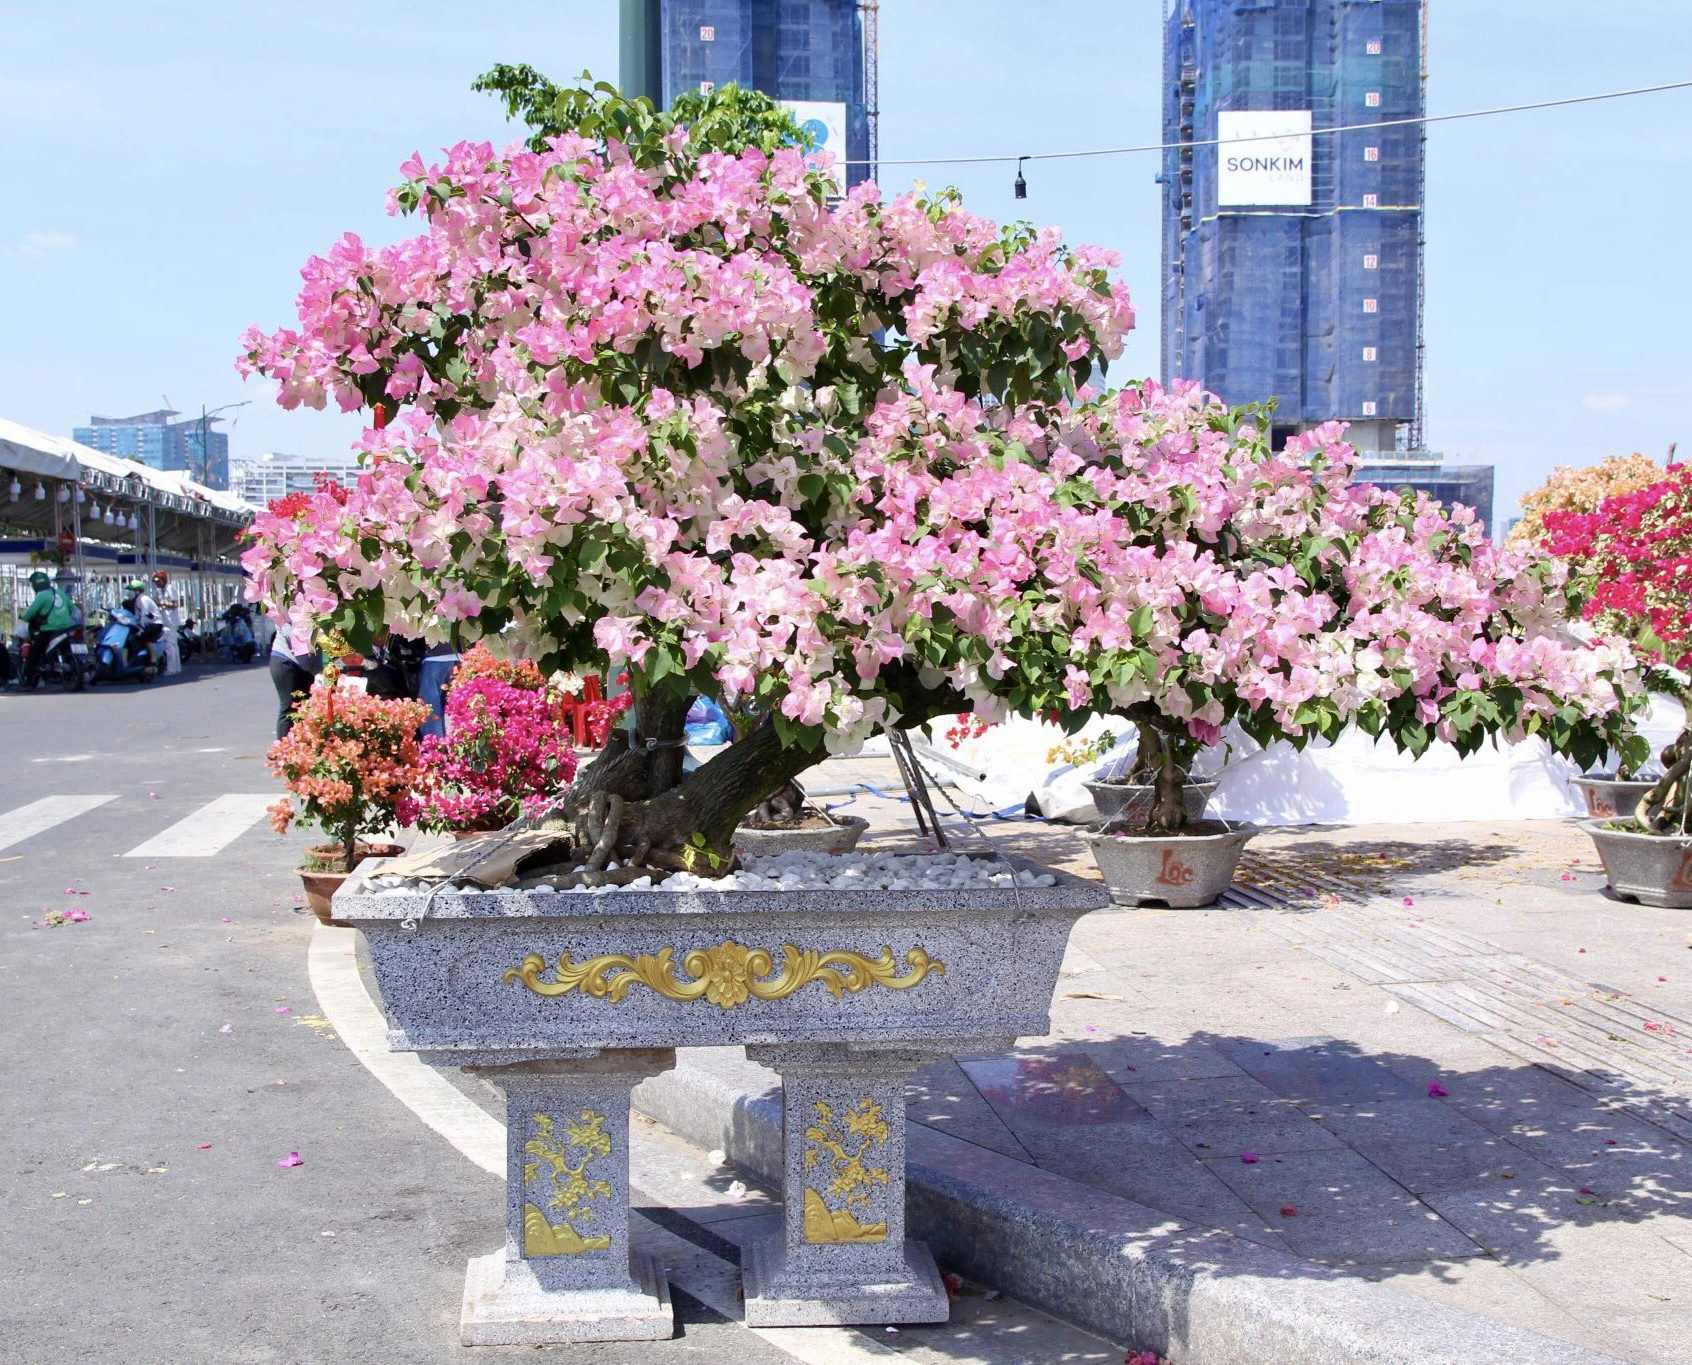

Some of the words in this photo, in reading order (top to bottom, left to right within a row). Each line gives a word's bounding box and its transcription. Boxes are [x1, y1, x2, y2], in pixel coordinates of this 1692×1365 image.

[701, 28, 714, 40] 20
[1367, 42, 1380, 53] 20
[1368, 94, 1378, 106] 18
[1366, 148, 1377, 160] 16
[1227, 157, 1303, 171] SONKIM
[1365, 195, 1376, 207] 14
[1366, 256, 1375, 268] 12
[1365, 300, 1375, 311] 10
